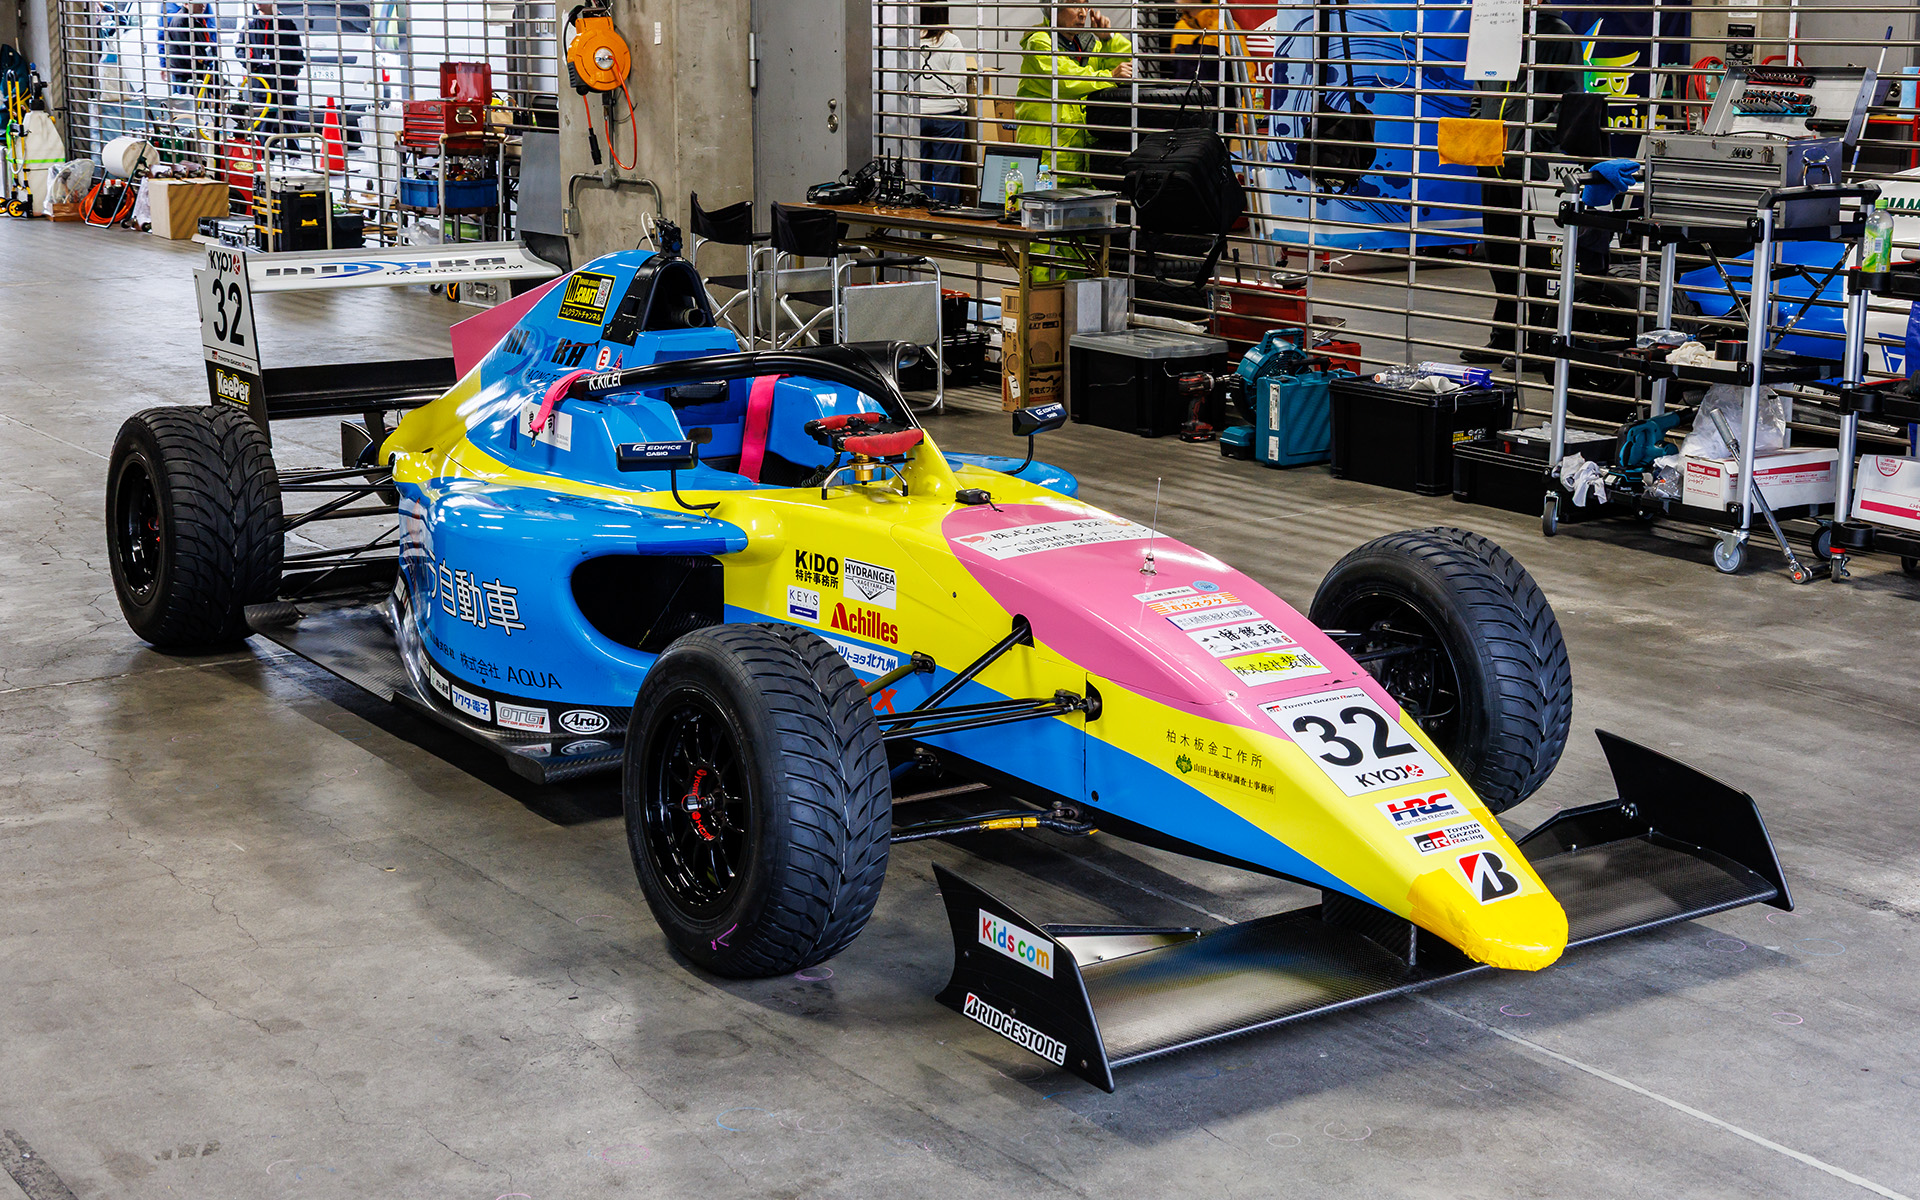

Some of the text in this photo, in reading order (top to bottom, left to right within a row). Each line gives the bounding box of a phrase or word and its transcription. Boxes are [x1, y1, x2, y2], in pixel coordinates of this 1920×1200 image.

[386, 263, 524, 277] RACING TEAM
[211, 278, 245, 347] 32
[215, 369, 250, 403] KeePer
[795, 549, 839, 577] KIDO
[844, 563, 896, 586] HYDRANGEA
[795, 568, 839, 590] 特許事務所
[830, 602, 899, 645] Achilles
[459, 650, 501, 681] 株式会社
[507, 665, 563, 690] AQUA
[834, 645, 896, 672] ツトヨタ北九州
[1283, 700, 1313, 711] TOYOTA
[1313, 695, 1340, 704] GAZOO
[1340, 692, 1365, 701] Racing
[564, 713, 602, 728] Arai
[1166, 729, 1262, 769] 柏木板金工作所
[1292, 706, 1419, 767] 32
[1387, 792, 1454, 822] HRC
[1396, 809, 1460, 827] Honda RACING
[1445, 822, 1480, 834] TOYOTA
[1448, 828, 1481, 840] GAZOO
[1451, 834, 1485, 845] Racing
[1417, 835, 1451, 852] GR
[982, 916, 1050, 971] Kids com
[964, 993, 1066, 1066] BRIDGESTONE
